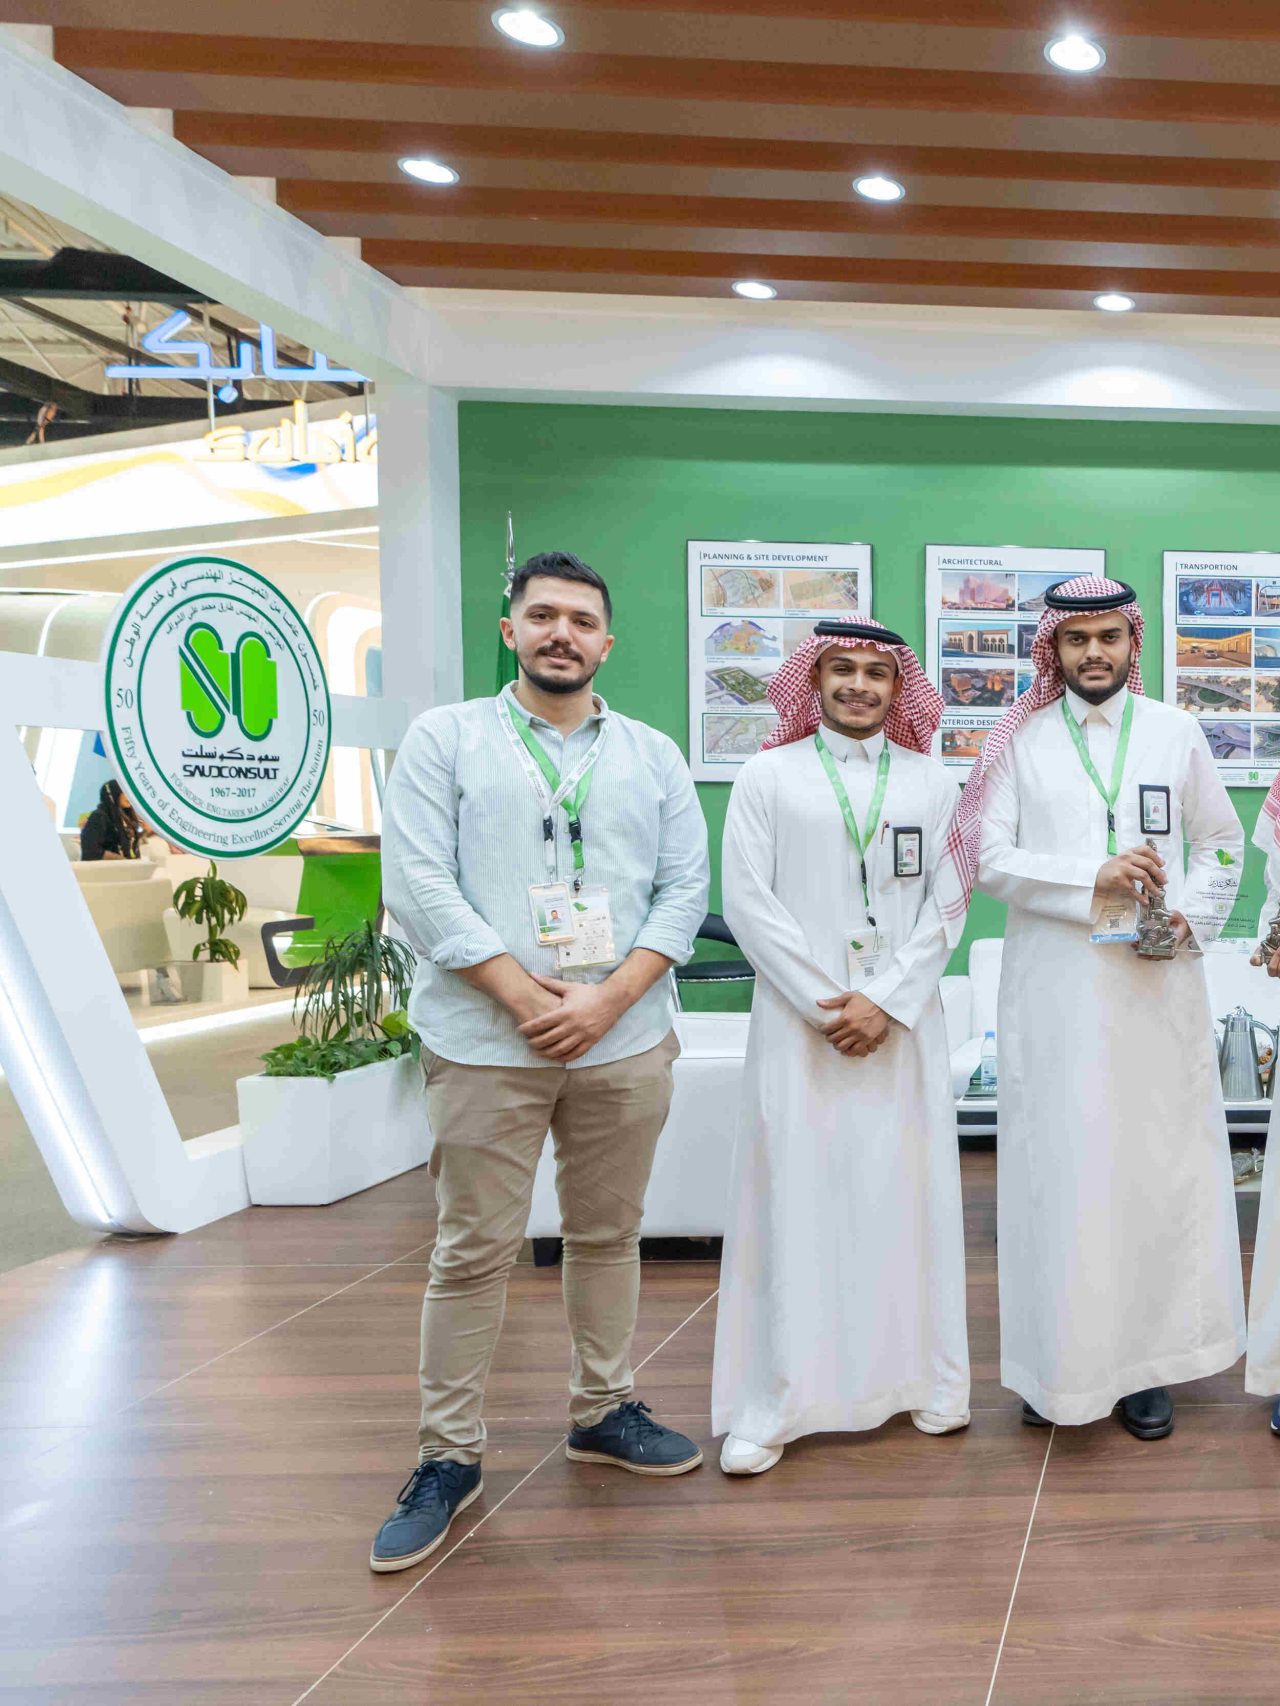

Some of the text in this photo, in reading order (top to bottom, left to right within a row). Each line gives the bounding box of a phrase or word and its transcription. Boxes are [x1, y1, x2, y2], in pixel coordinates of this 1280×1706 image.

[703, 552, 830, 562] PLANNING & SITE DEVELOPMENT
[942, 558, 1003, 566] ARCHITECTURAL
[1179, 563, 1238, 571] TRANSPORTION
[116, 688, 134, 709] 50
[312, 709, 325, 727] 50
[121, 726, 137, 760] Fifty
[134, 761, 157, 799] Years
[156, 798, 170, 811] of
[168, 808, 229, 847] Engineering
[298, 781, 313, 799] The
[309, 739, 324, 778] Nation
